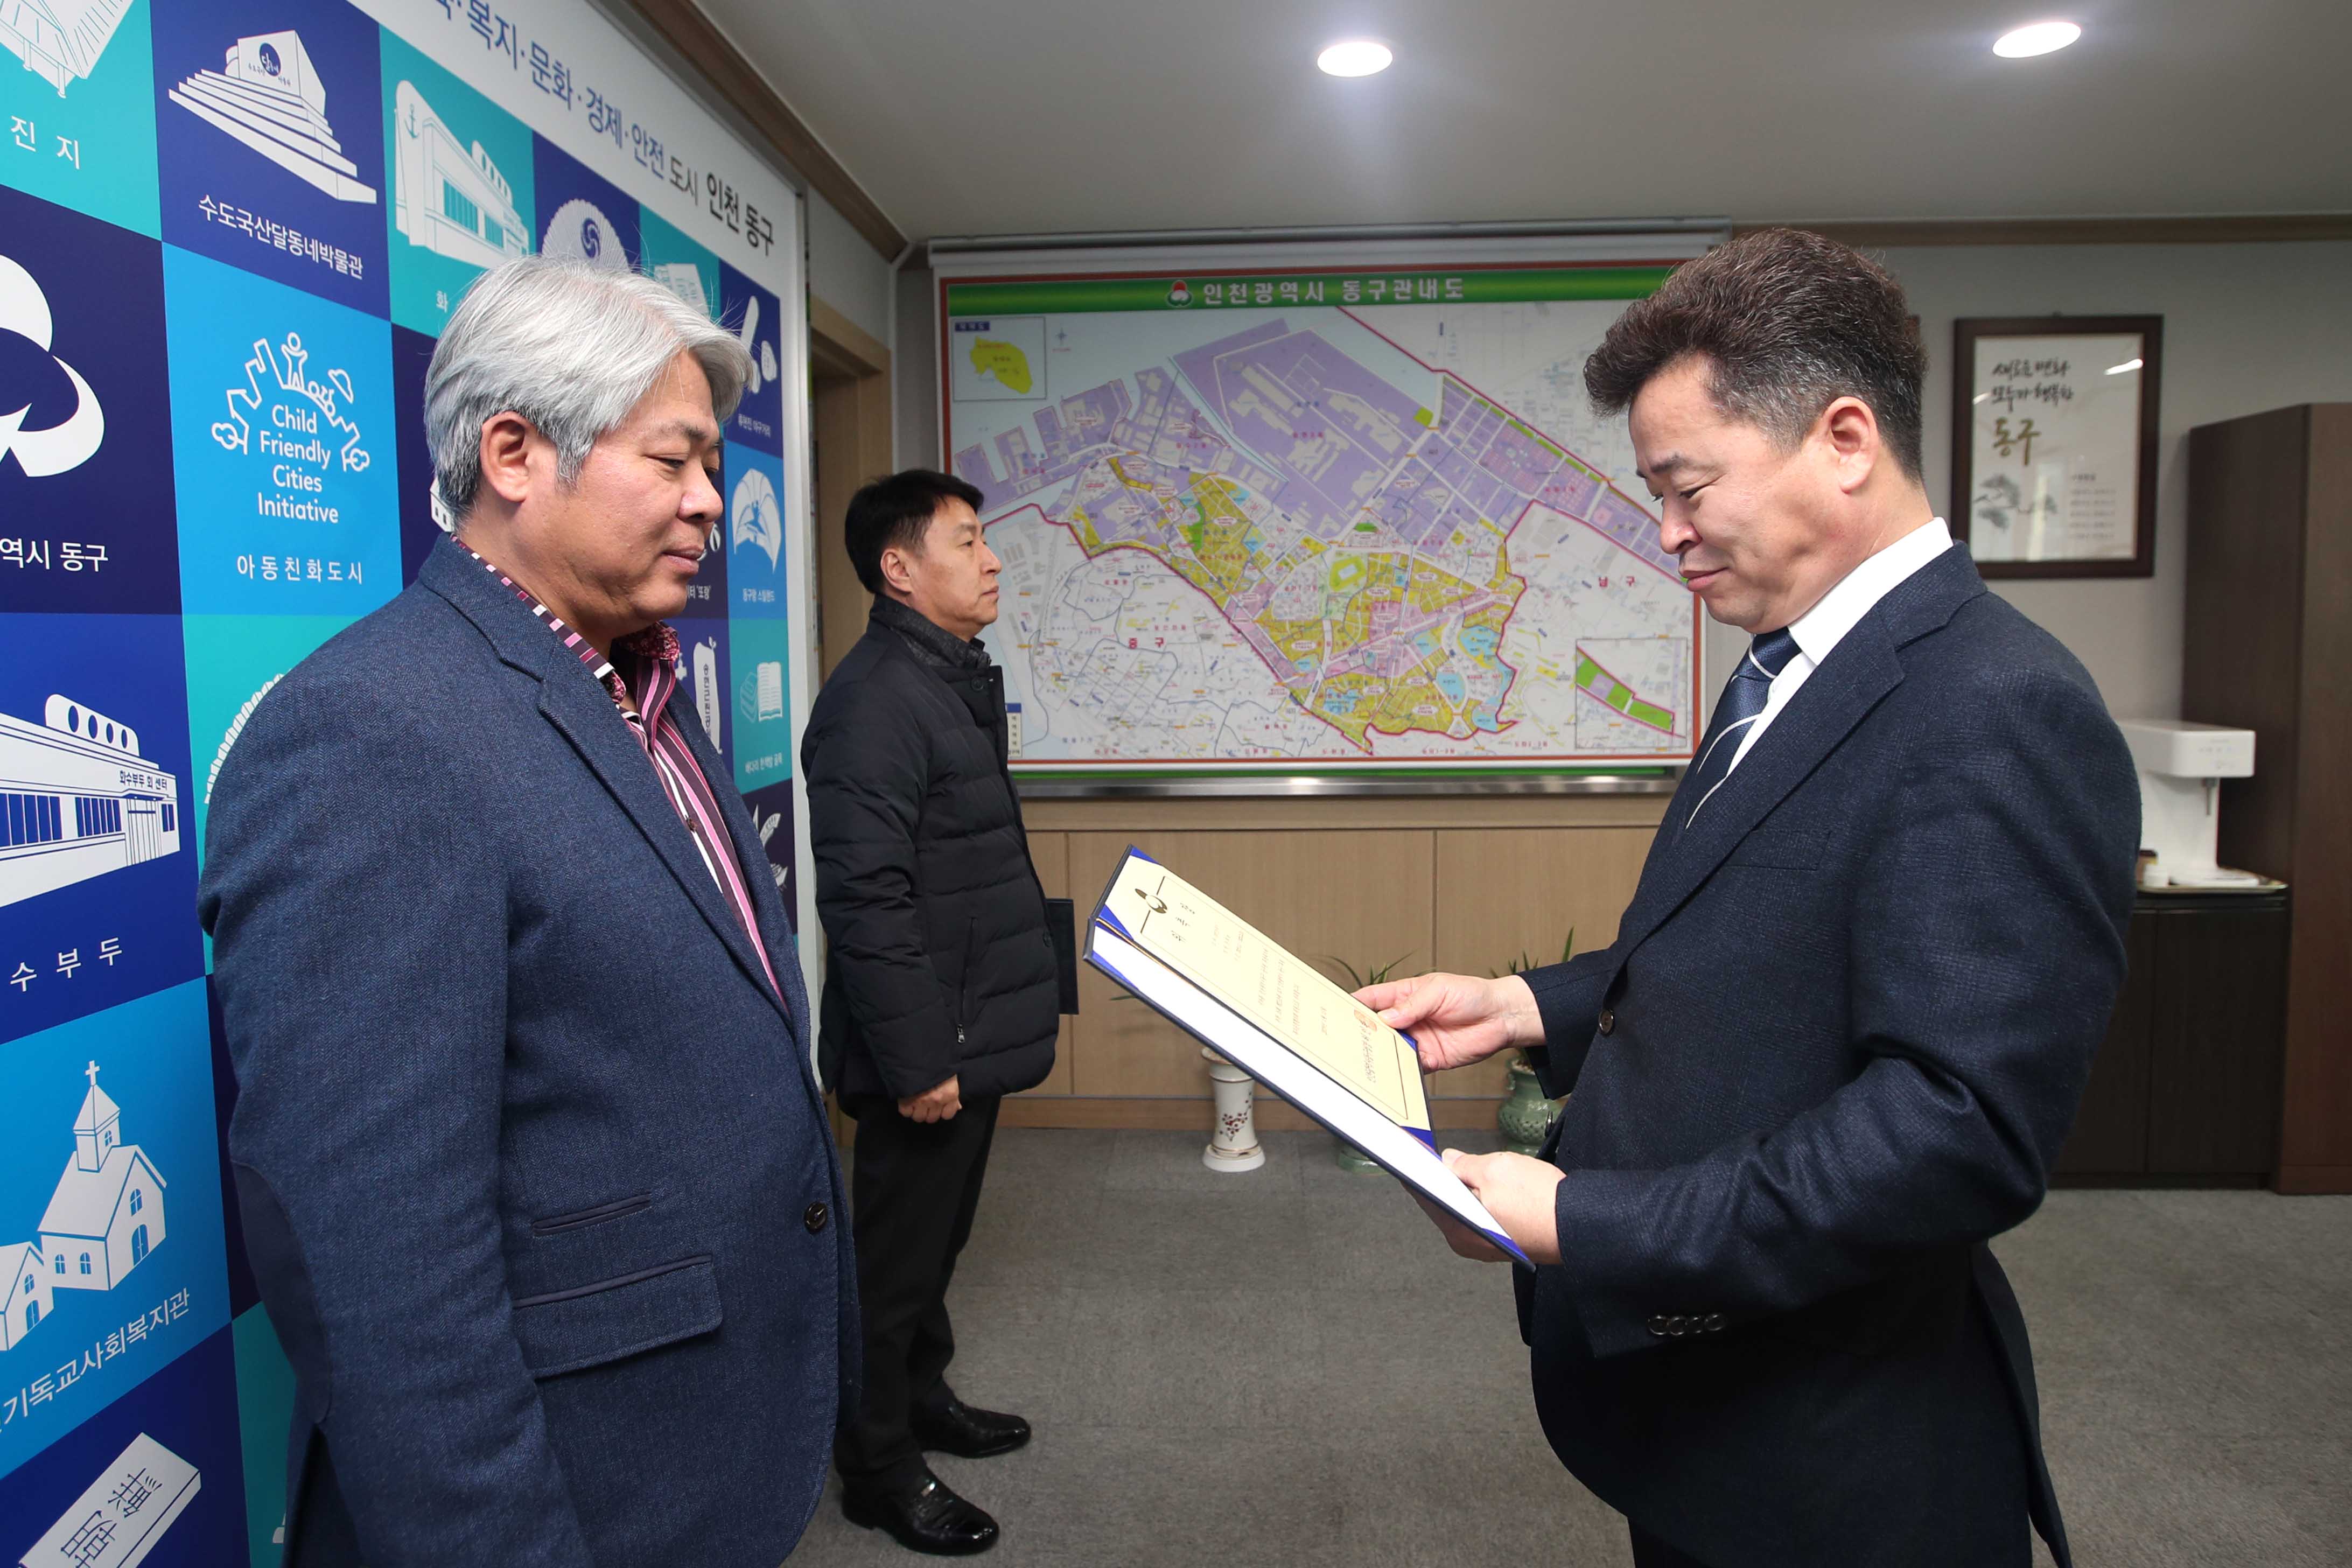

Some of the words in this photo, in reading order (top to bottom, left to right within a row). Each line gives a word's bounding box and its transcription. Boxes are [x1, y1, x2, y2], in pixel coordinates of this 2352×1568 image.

[669, 156, 698, 206] 도시
[706, 172, 740, 234] 인천
[745, 202, 774, 256] 동구
[198, 194, 363, 280] 수도국산달동네박물관
[1203, 280, 1325, 305] 인천광역시
[1342, 277, 1464, 302] 동구관내도
[272, 404, 318, 435] Child
[260, 431, 331, 470] Friendly
[1993, 417, 2042, 466] 동구
[272, 464, 323, 493] Cities
[258, 492, 339, 524] Initiative
[60, 542, 109, 572] 동구
[0, 1287, 190, 1433] 기독교사회복지관
